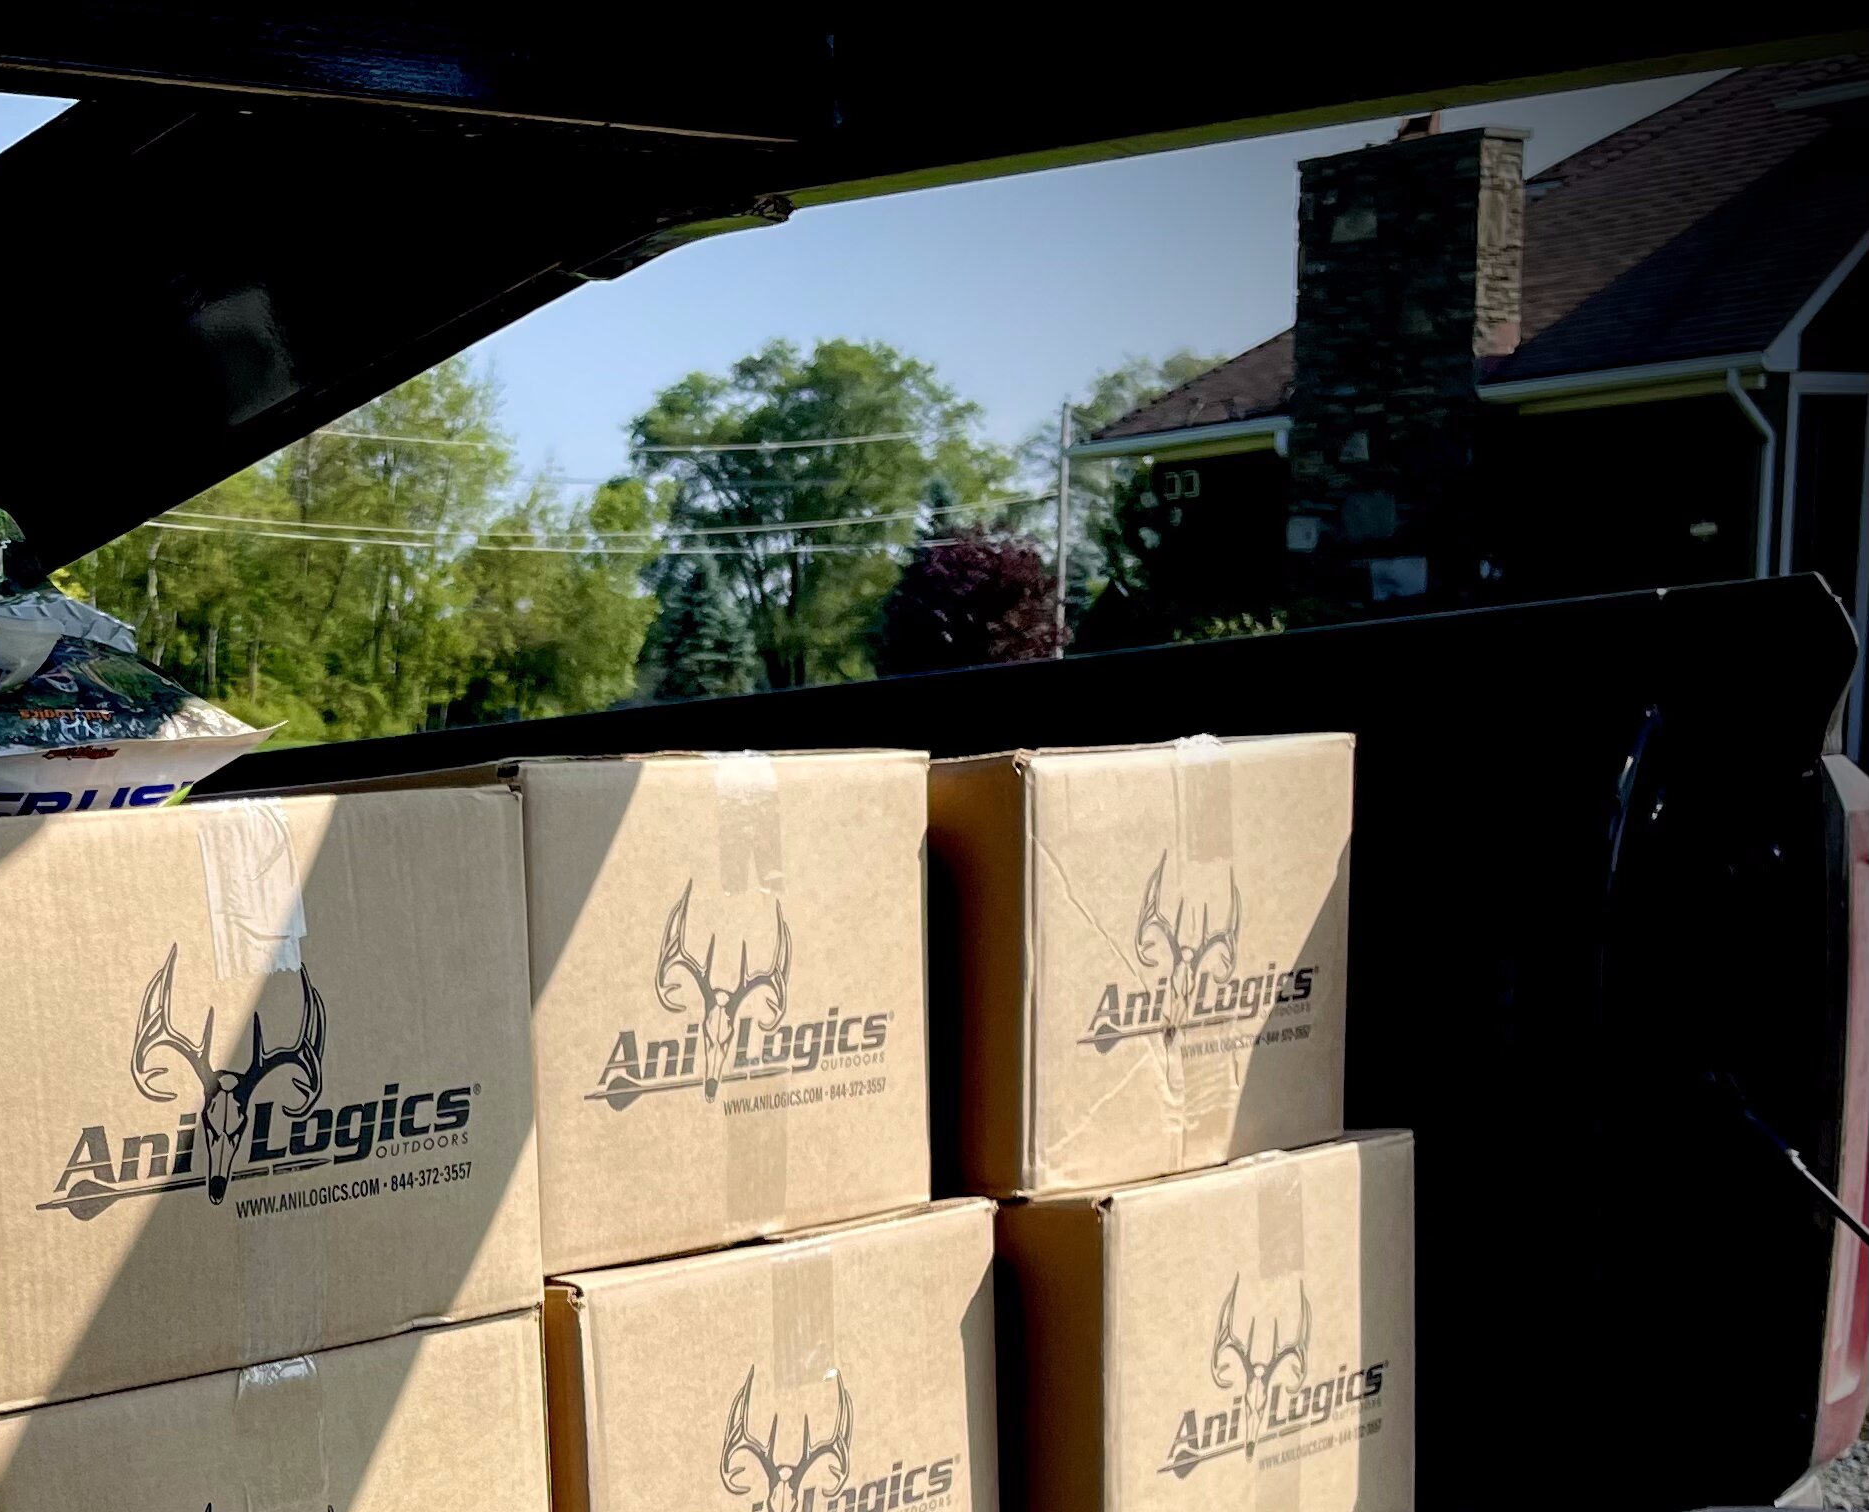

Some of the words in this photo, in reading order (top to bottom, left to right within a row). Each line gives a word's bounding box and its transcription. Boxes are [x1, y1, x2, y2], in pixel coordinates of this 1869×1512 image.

[1087, 977, 1168, 1032] Ani
[597, 1022, 699, 1086] Ani
[733, 1007, 888, 1073] Logics
[820, 1052, 885, 1072] OUTDOORS
[723, 1088, 823, 1116] WWW.ANILOGICS.COM
[829, 1077, 887, 1102] 844-372-3557
[53, 1112, 197, 1193] Ani
[248, 1083, 472, 1165] Logics
[375, 1131, 469, 1159] OUTDOORS
[235, 1179, 381, 1220] WWW.ANILOGICS.COM
[390, 1161, 473, 1193] 844-372-3557
[1167, 1396, 1243, 1458] Ani
